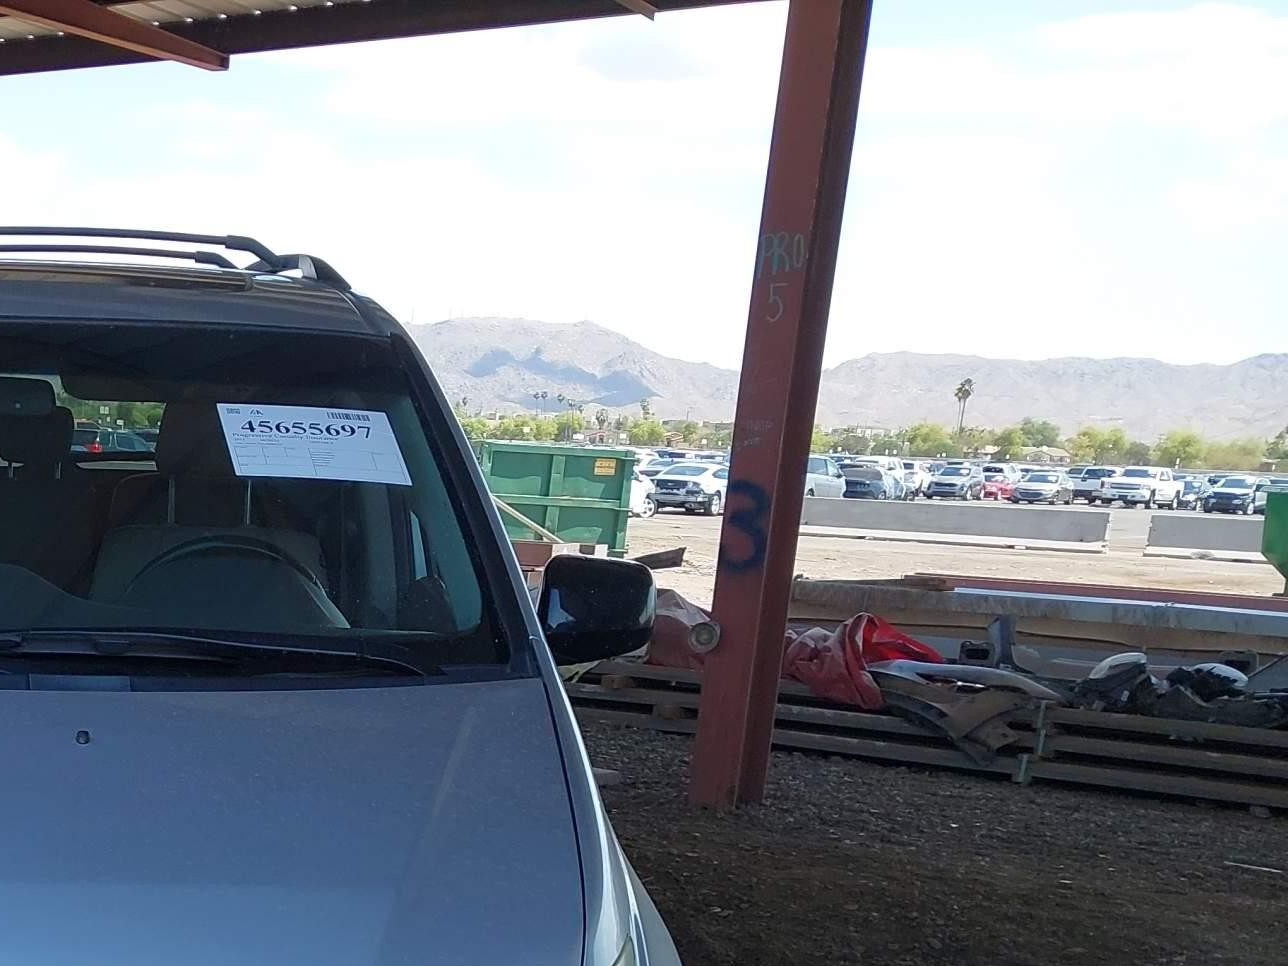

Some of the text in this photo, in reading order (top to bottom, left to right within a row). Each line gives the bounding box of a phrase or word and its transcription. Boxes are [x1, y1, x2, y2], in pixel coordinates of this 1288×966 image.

[766, 283, 789, 323] 5
[240, 419, 372, 439] 45655697
[722, 478, 769, 575] 3
